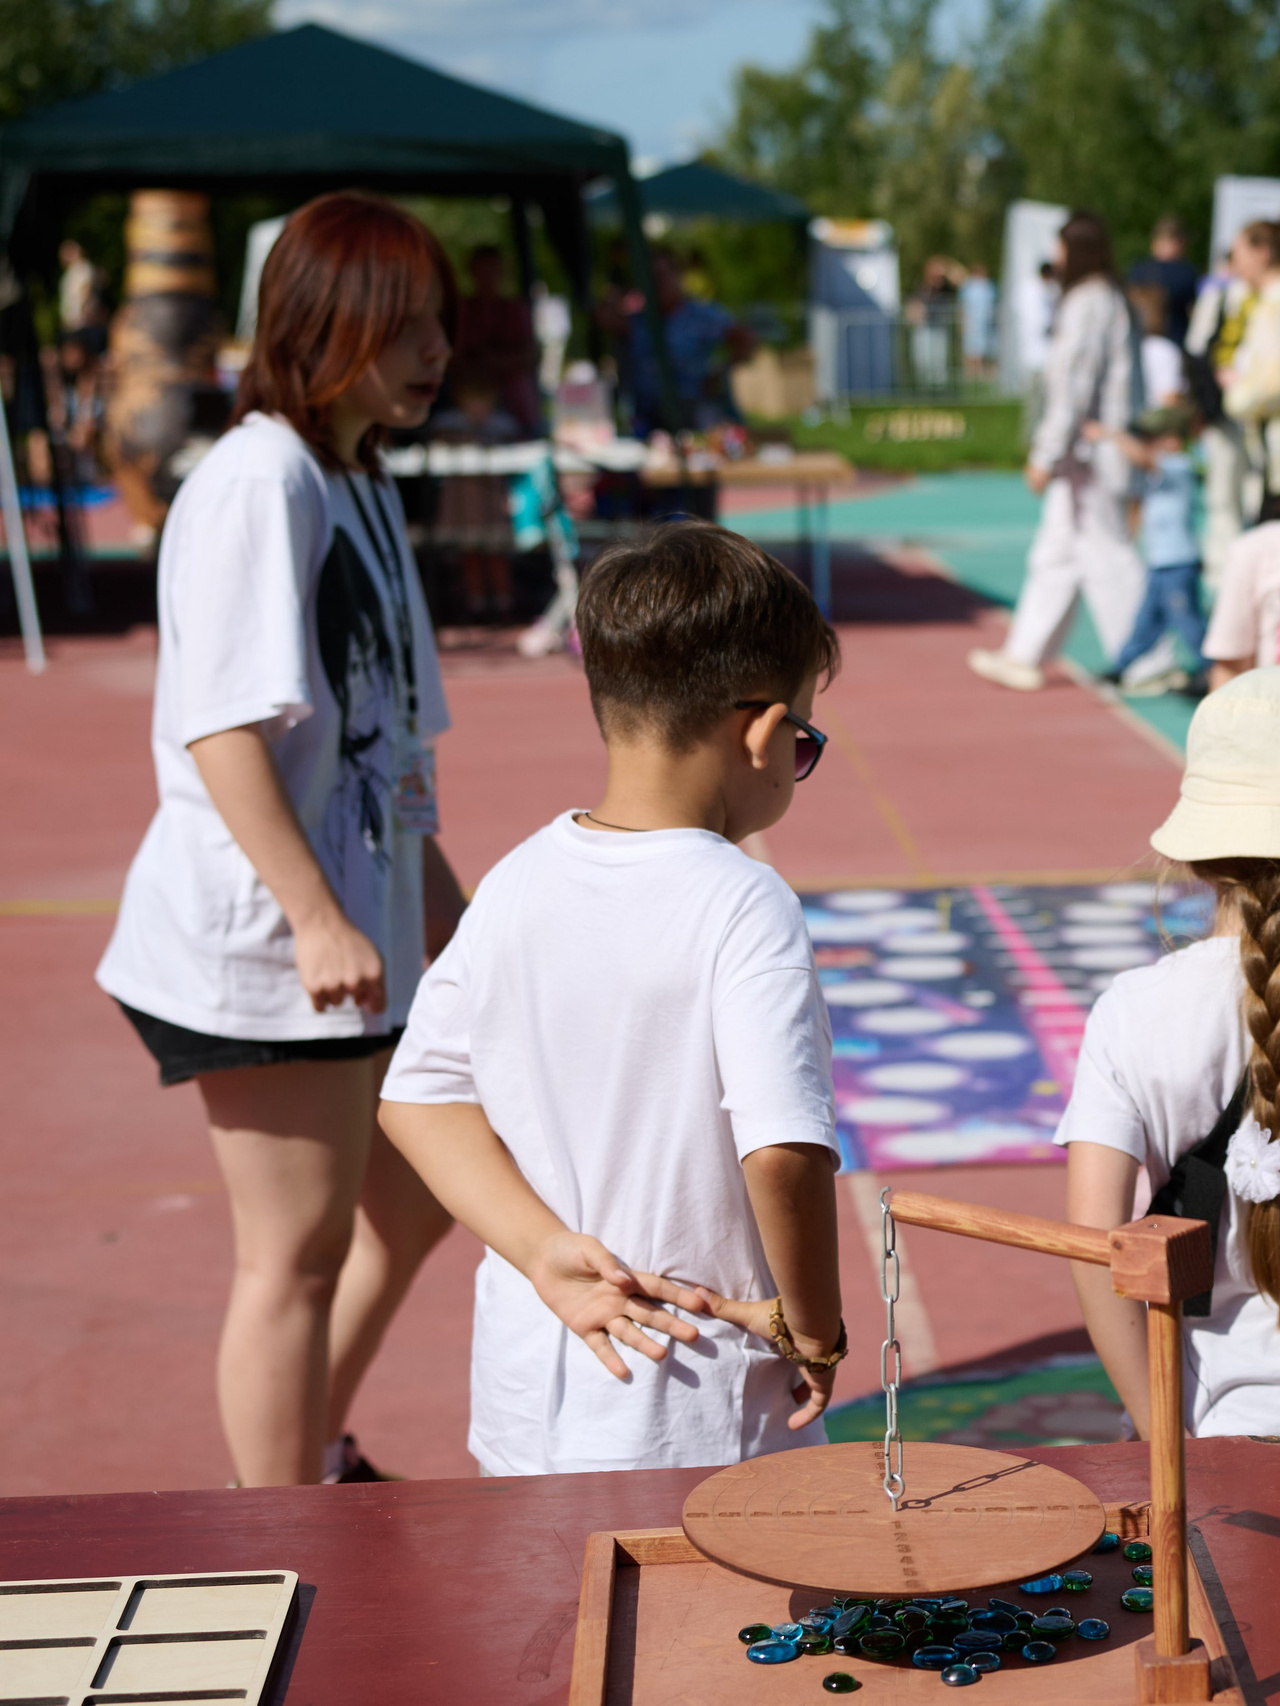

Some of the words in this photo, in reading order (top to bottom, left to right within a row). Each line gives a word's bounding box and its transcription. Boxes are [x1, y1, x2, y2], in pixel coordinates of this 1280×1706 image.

[891, 1520, 903, 1530] 1
[894, 1532, 908, 1542] 2
[896, 1543, 912, 1553] 3
[899, 1555, 915, 1565] 4
[903, 1567, 919, 1577] 5
